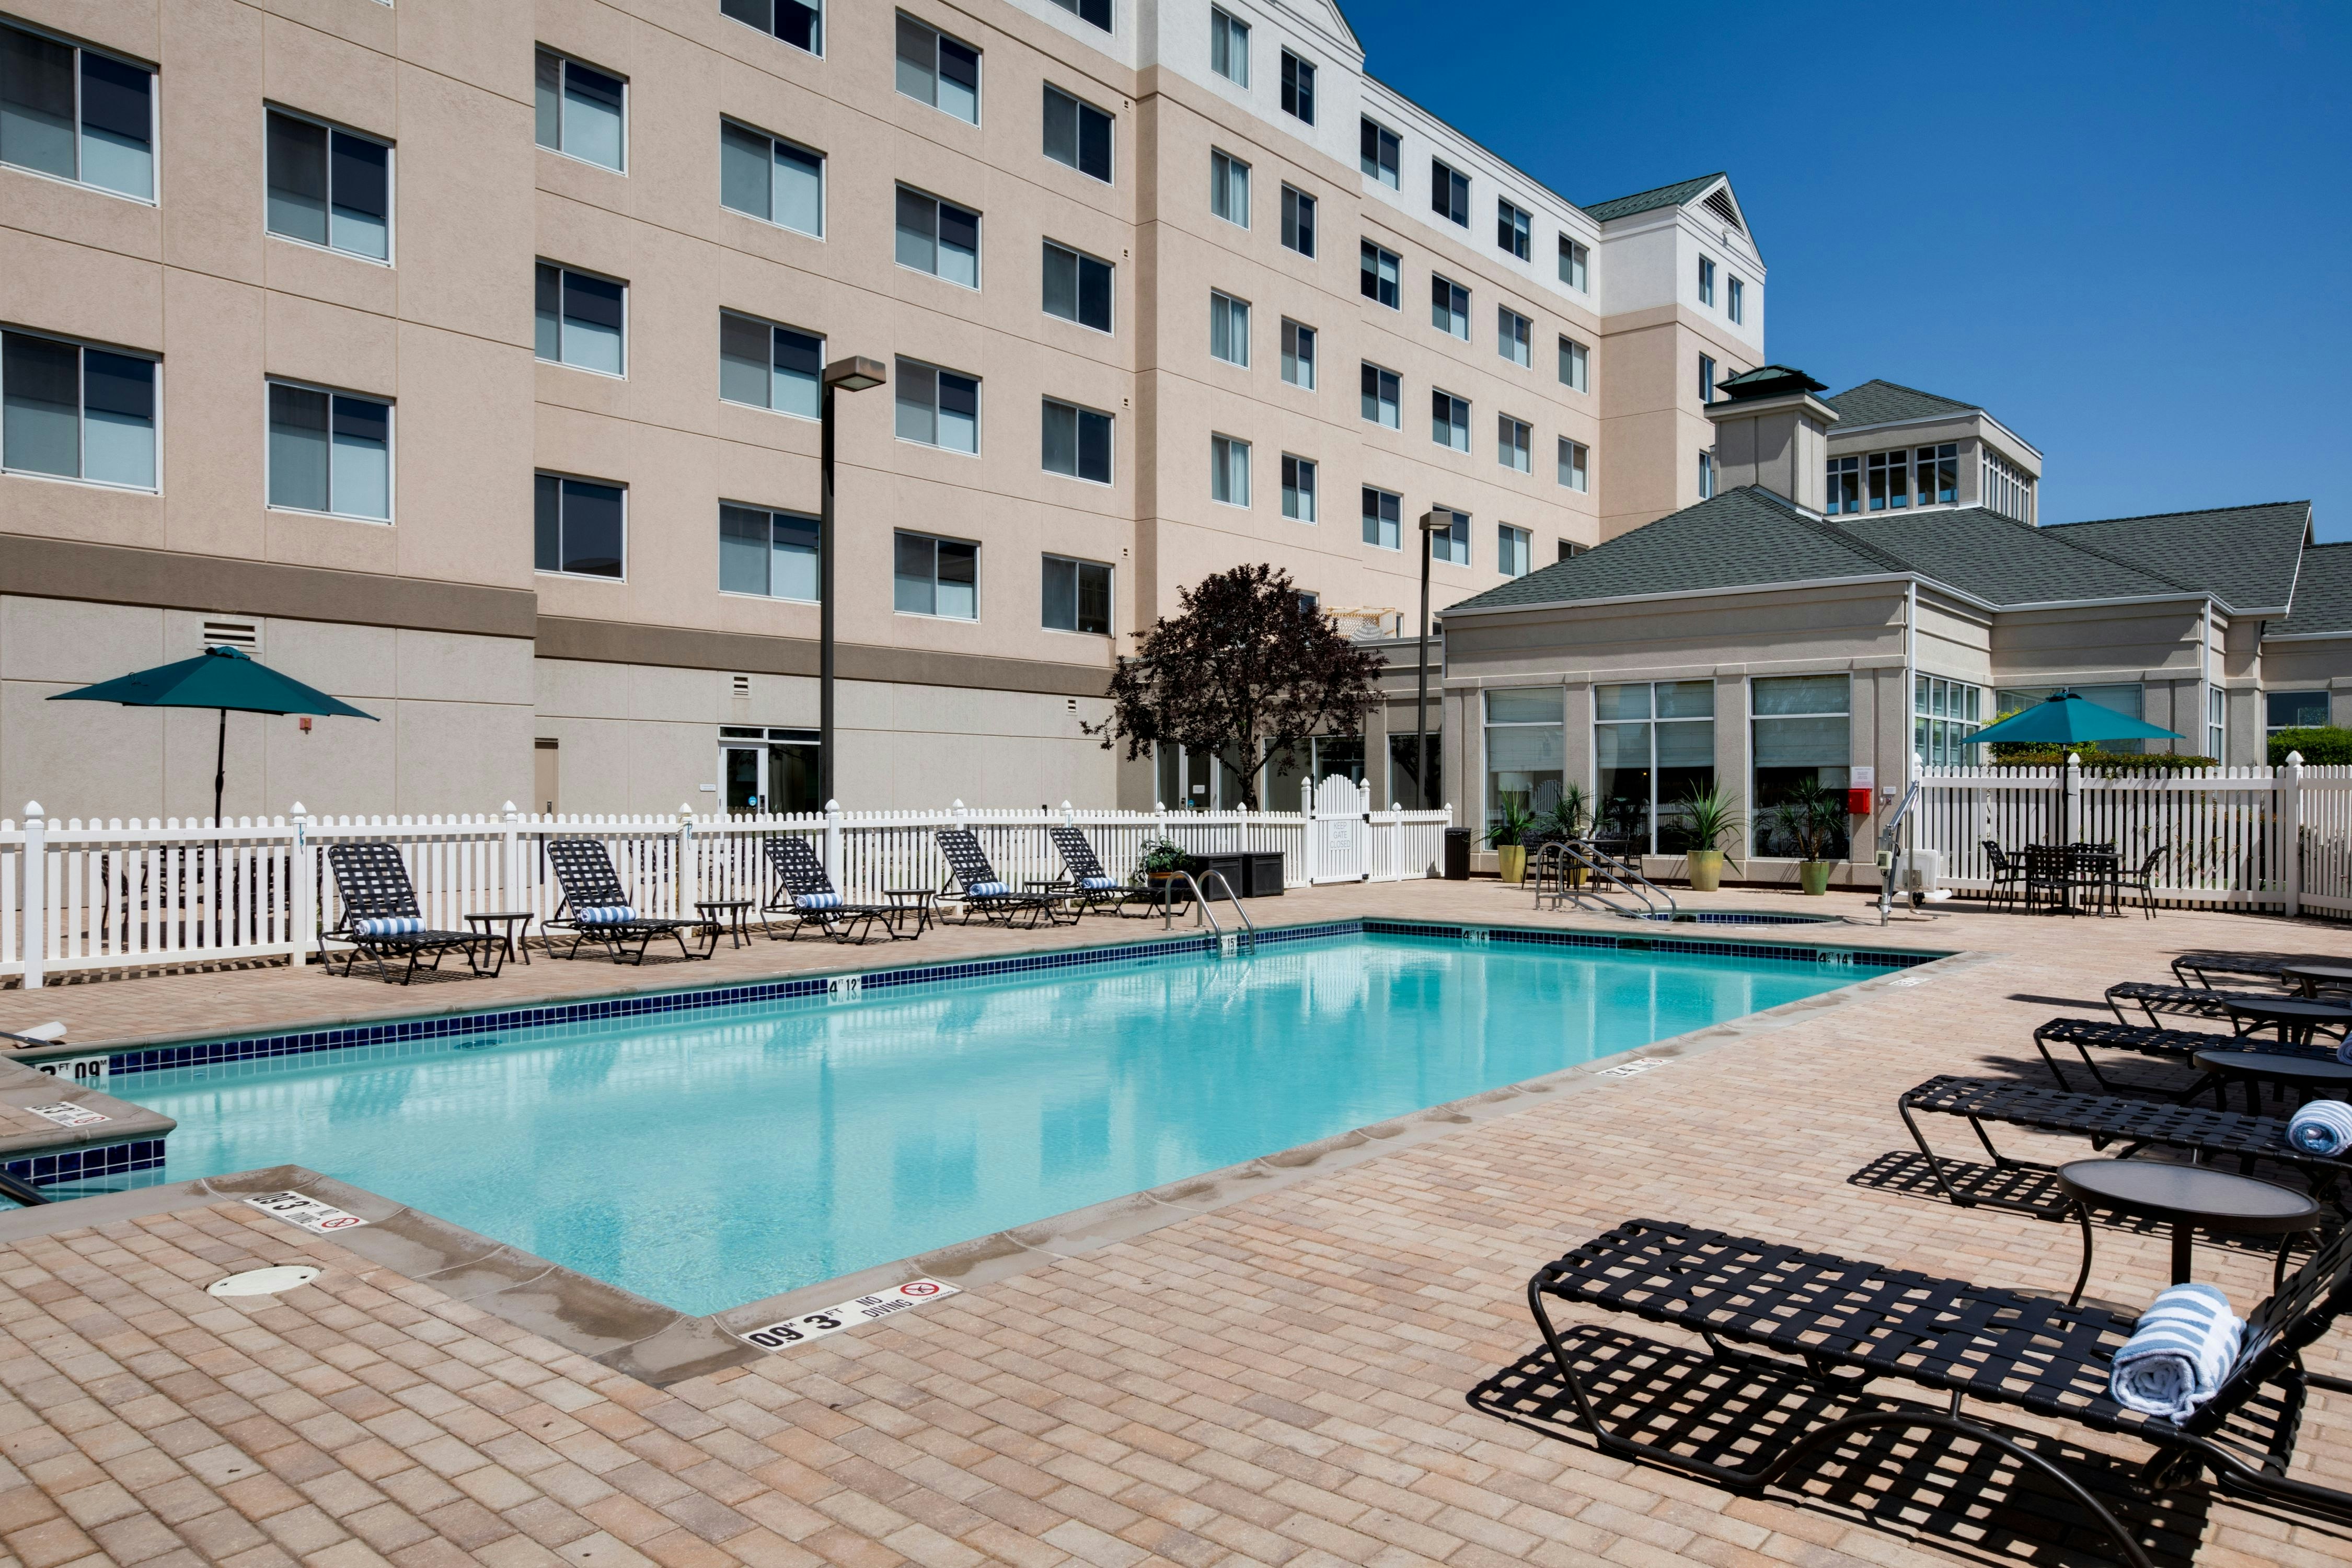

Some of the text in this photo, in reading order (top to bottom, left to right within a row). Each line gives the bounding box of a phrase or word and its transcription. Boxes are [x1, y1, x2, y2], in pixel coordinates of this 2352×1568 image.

[829, 981, 838, 992] 4
[846, 978, 857, 990] 12
[59, 1063, 71, 1071] FT
[272, 1201, 310, 1210] 3
[855, 1296, 883, 1307] NO
[861, 1299, 915, 1318] DIVING
[803, 1315, 841, 1329] 3
[824, 1308, 844, 1316] FT
